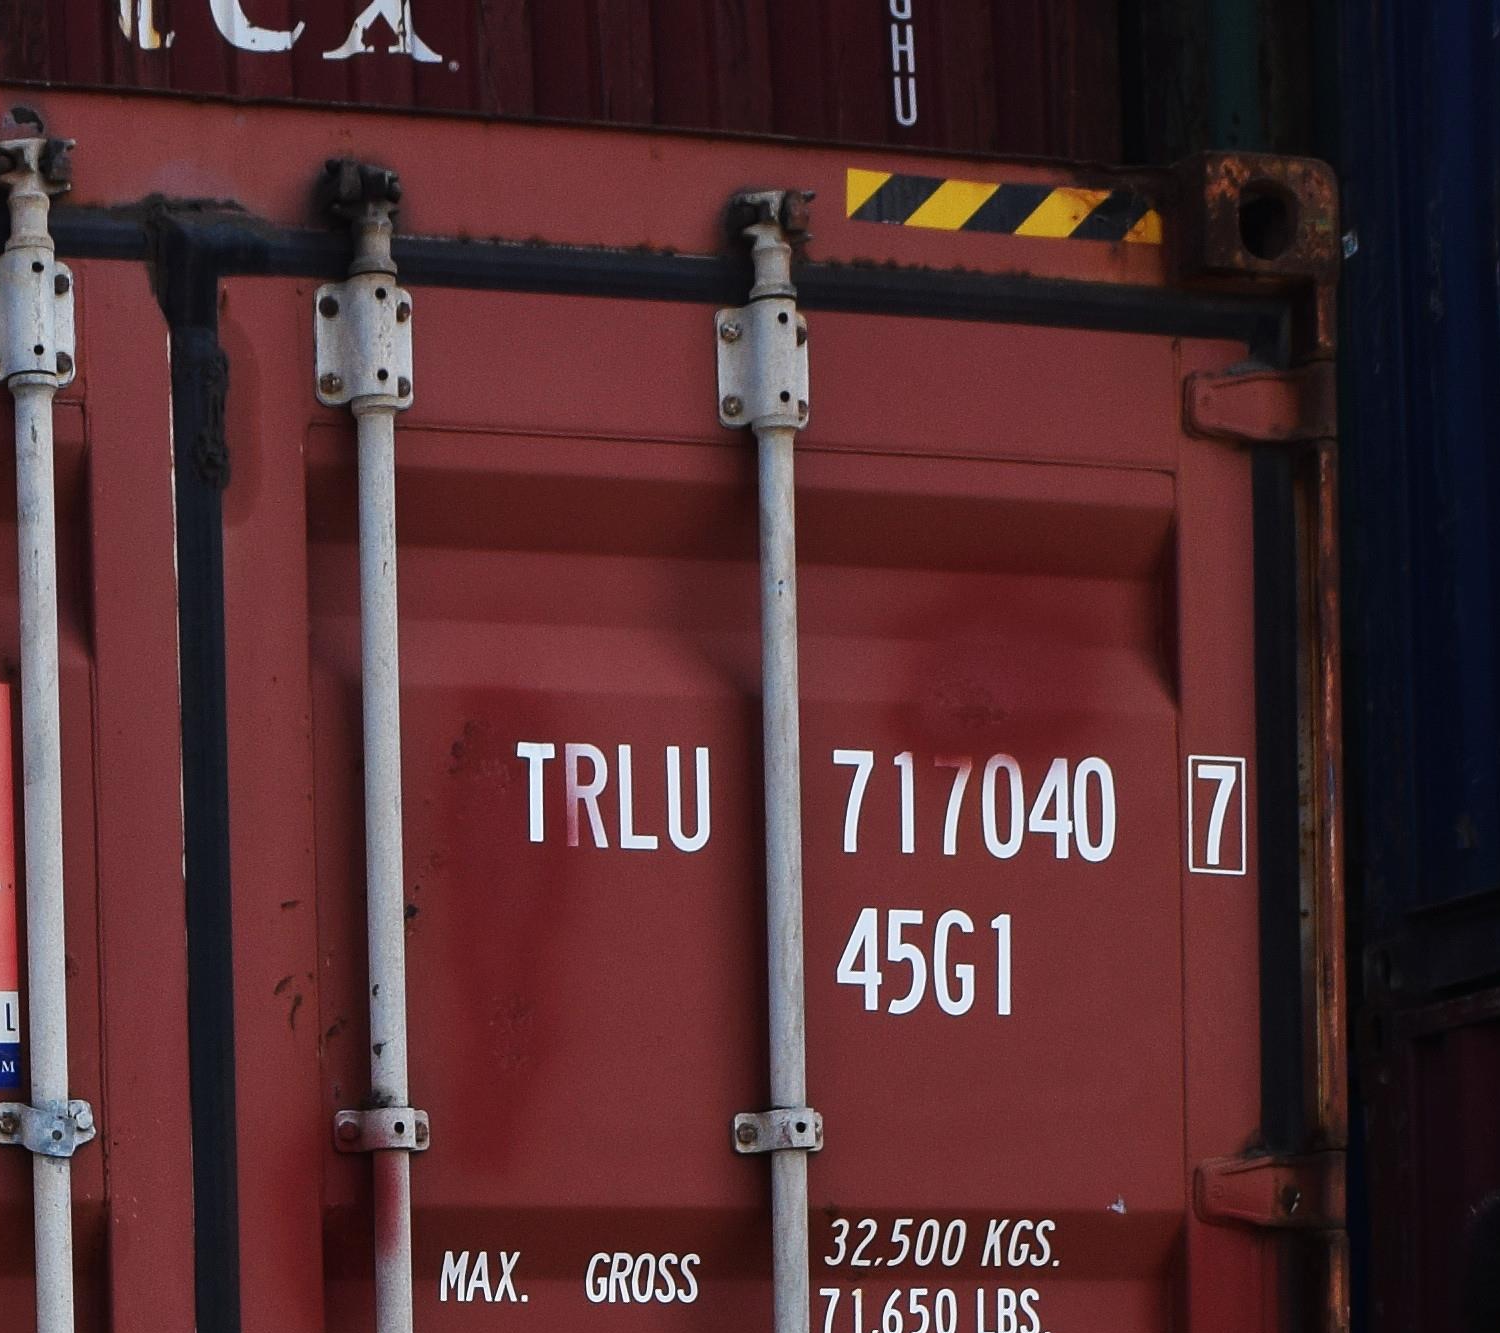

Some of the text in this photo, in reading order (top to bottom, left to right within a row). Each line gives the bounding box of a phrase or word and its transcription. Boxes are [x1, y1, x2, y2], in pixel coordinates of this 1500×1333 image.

[516, 741, 1237, 867] TRLU 717040 7
[836, 907, 1014, 1016] 45G1
[439, 1250, 701, 1304] MAX. GROSS
[981, 1218, 1061, 1268] KGS.
